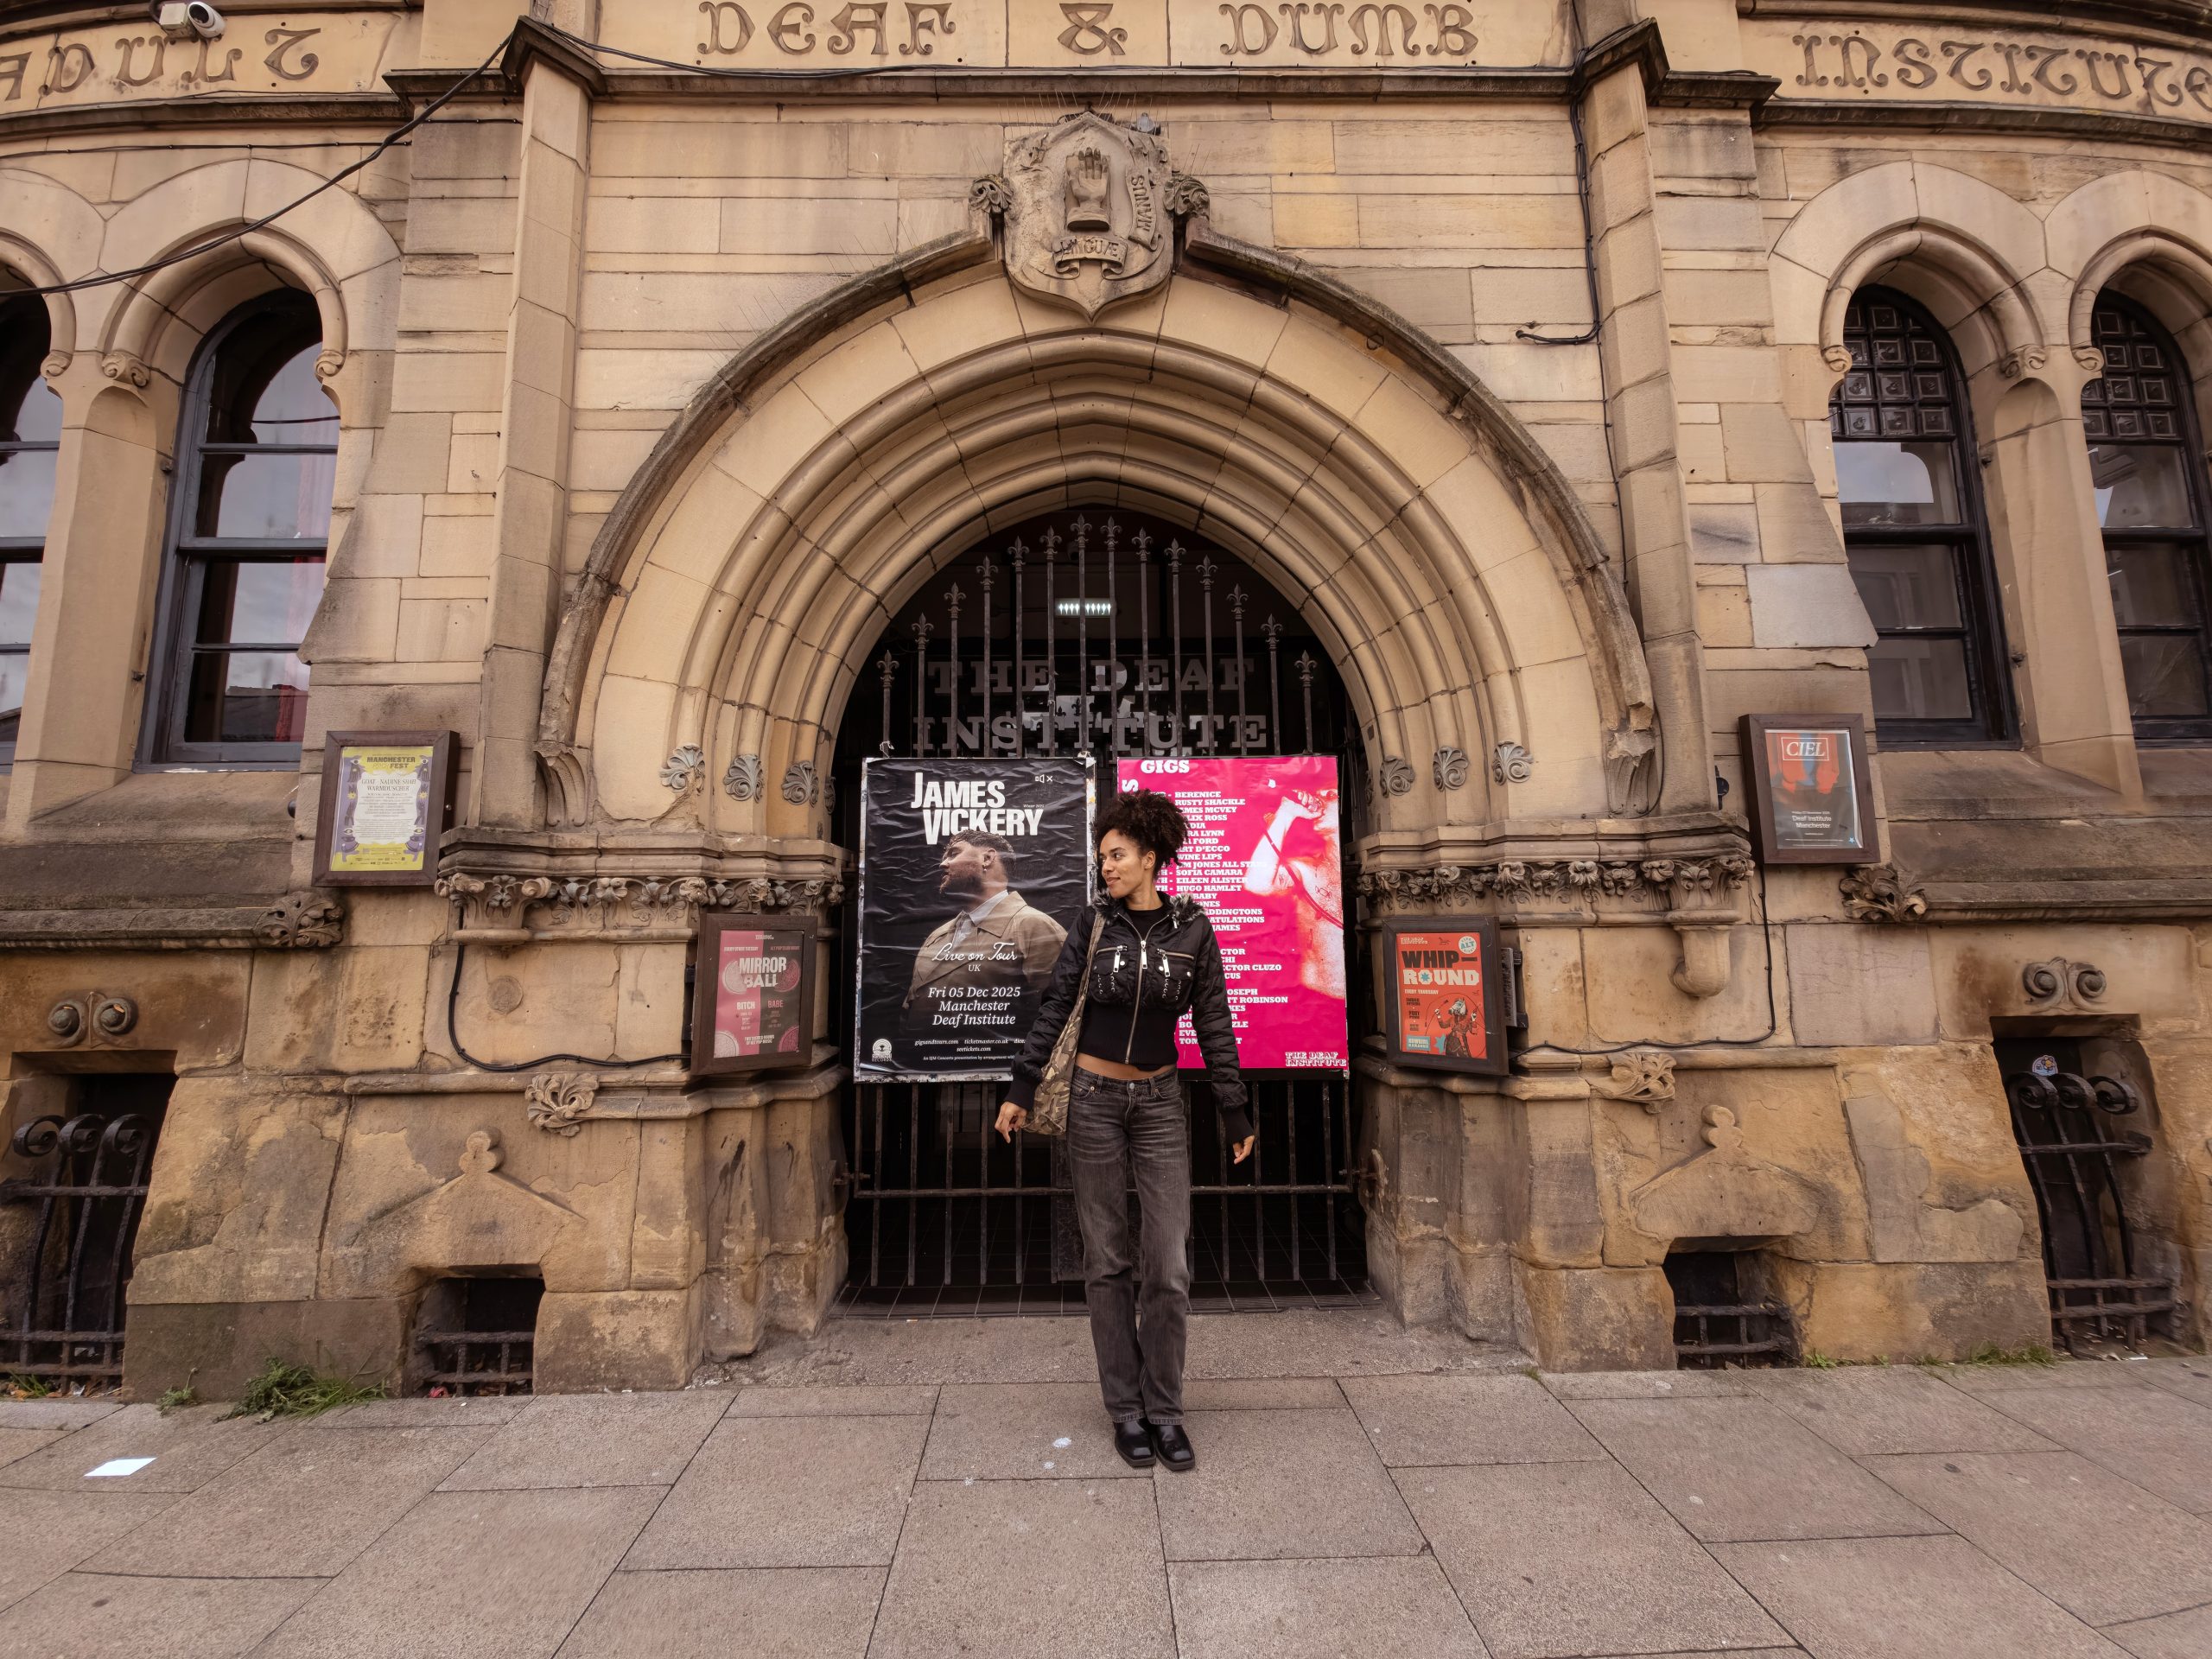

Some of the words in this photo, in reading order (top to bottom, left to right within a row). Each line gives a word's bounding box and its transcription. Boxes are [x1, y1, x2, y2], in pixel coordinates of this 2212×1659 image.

[697, 2, 956, 55] DEAF
[1058, 3, 1128, 55] &
[1218, 3, 1478, 56] DUMB
[1793, 35, 2212, 112] INSTITUTE
[928, 660, 1050, 694] THE
[1090, 658, 1253, 691] DEAF
[913, 715, 1266, 751] INSTITUTE
[1786, 742, 1825, 757] CIEL
[1141, 760, 1190, 774] GIGS
[911, 772, 1006, 809] JAMES
[923, 809, 1044, 845] VICKERY
[932, 943, 965, 961] Live
[968, 951, 985, 961] on
[988, 942, 1018, 961] Tour
[740, 957, 787, 973] MIRROR
[744, 974, 778, 988] BALL
[1403, 969, 1479, 985] ROUND
[928, 987, 946, 998] Fri
[949, 988, 963, 997] 05
[967, 987, 988, 997] Dec
[991, 987, 1020, 997] 2025
[938, 1000, 1010, 1012] Manchester
[932, 1014, 963, 1027] Deaf
[963, 1013, 1016, 1026] Institute
